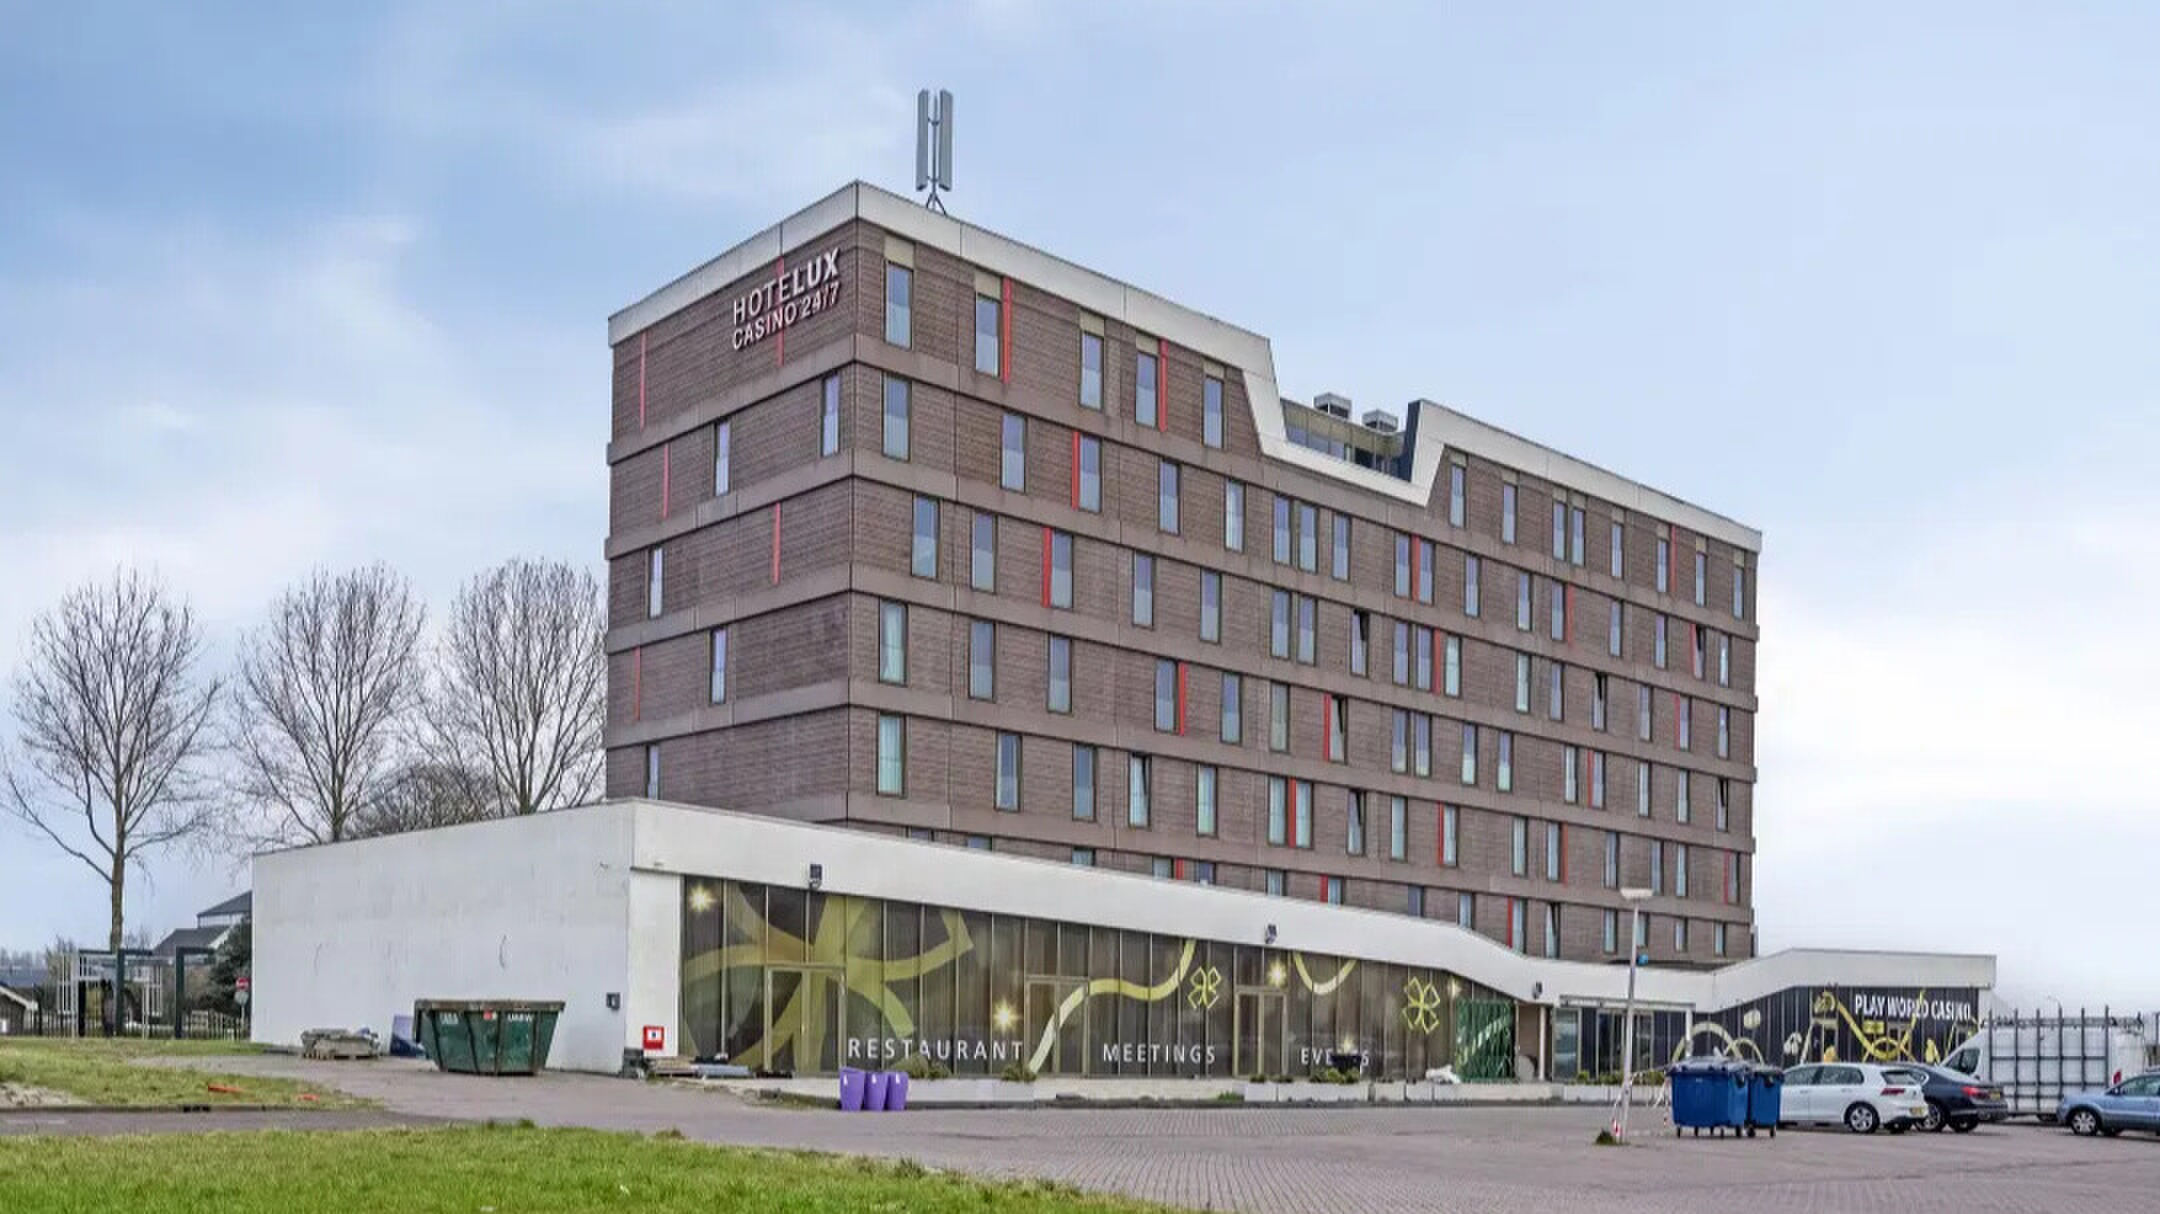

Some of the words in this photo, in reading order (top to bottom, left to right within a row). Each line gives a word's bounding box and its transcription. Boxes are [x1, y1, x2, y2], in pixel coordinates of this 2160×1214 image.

[731, 301, 797, 350] CASINO
[800, 281, 841, 319] 24/7
[1855, 994, 1886, 1018] PLAY
[1887, 995, 1929, 1019] WORLD
[1930, 1000, 1971, 1021] CASINO
[848, 1037, 1024, 1060] RESTAURANT
[1103, 1042, 1216, 1065] MEETINGS
[1300, 1047, 1370, 1067] EVES
